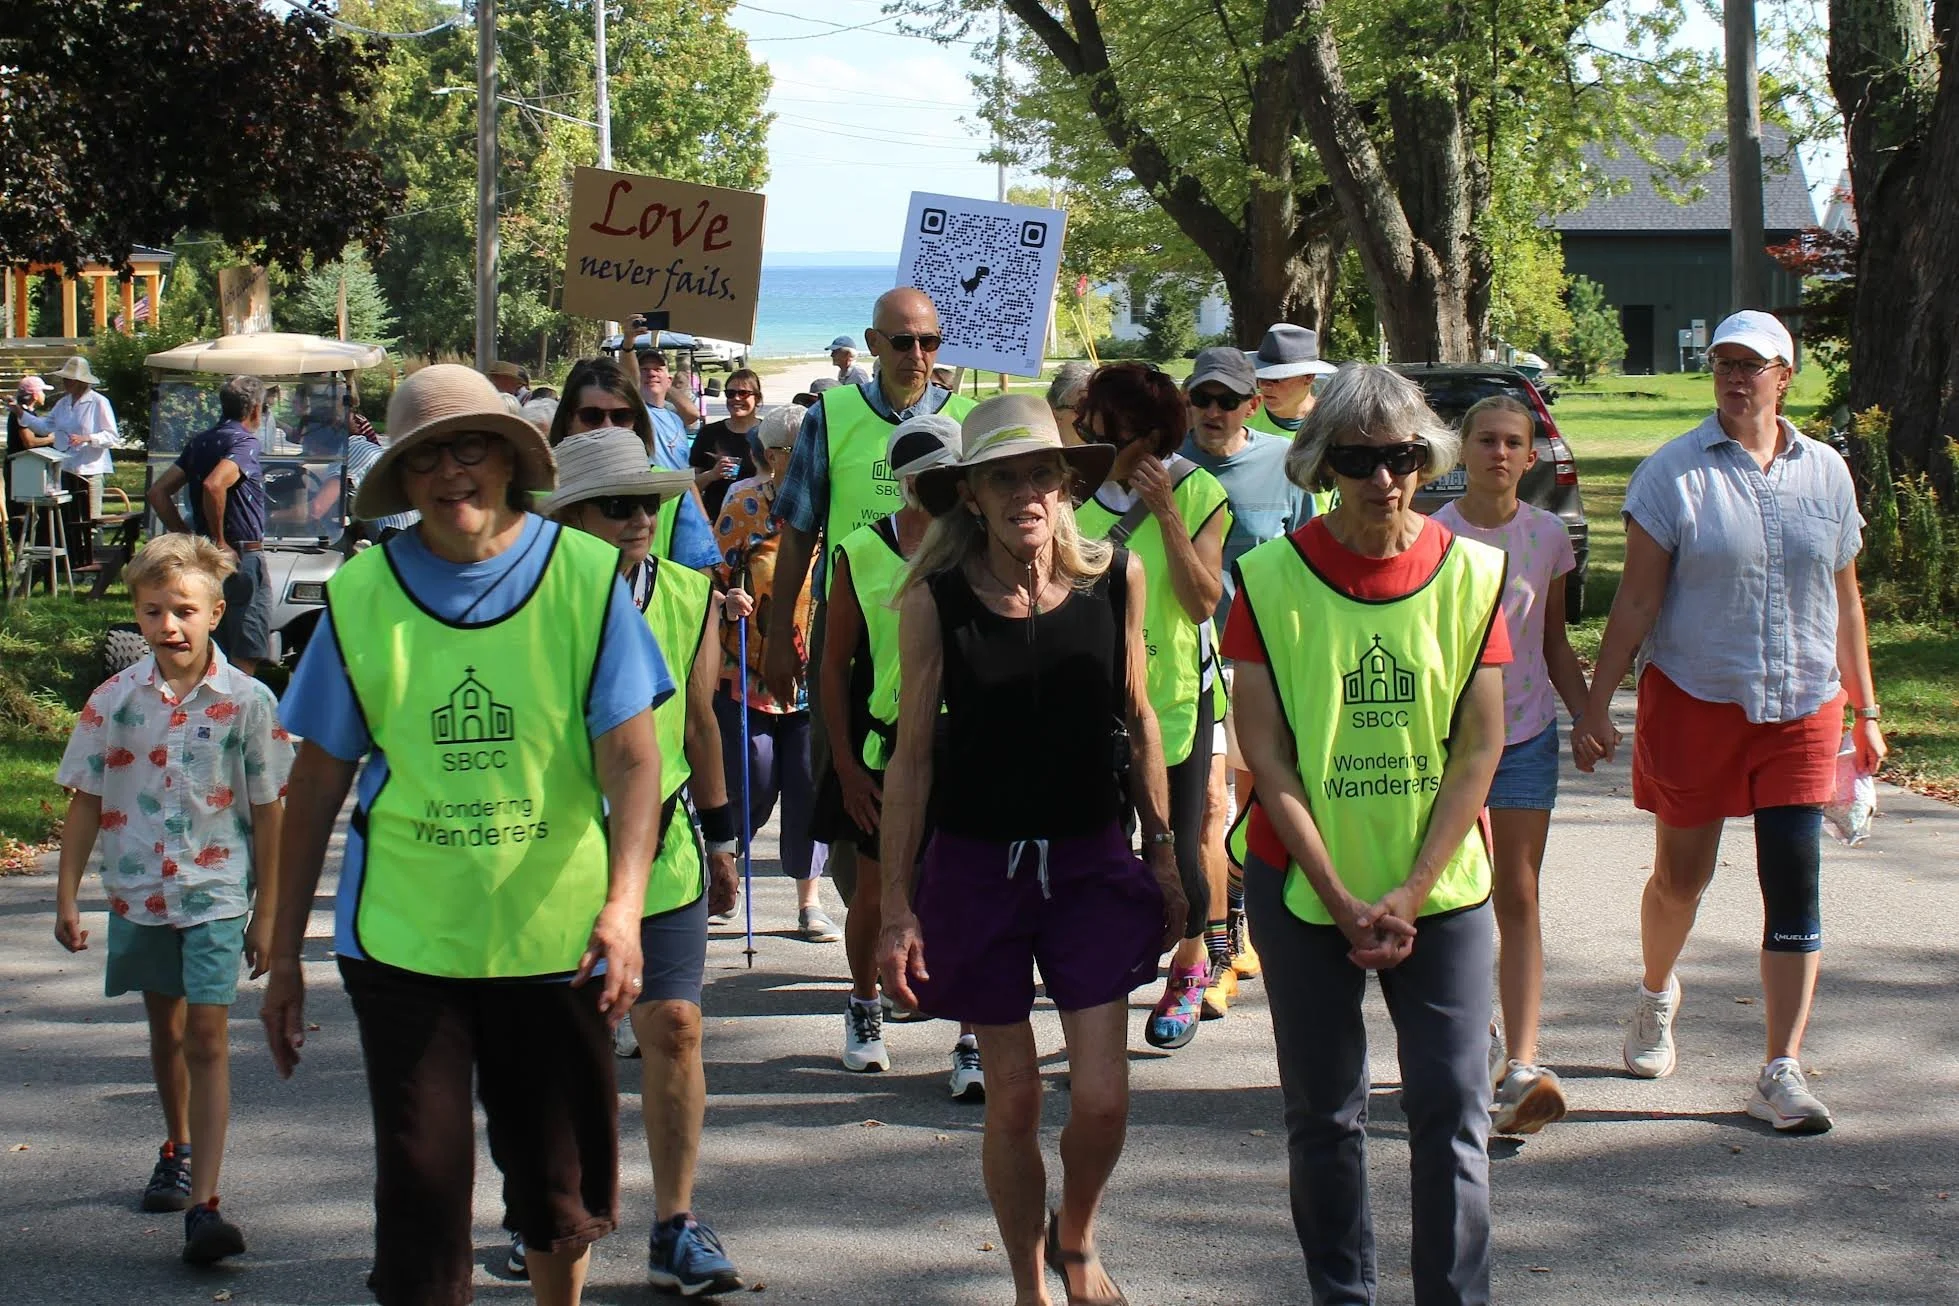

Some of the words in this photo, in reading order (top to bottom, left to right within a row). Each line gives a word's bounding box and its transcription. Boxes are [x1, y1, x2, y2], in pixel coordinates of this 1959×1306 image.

[589, 179, 732, 251] Love
[579, 256, 660, 286] never
[654, 258, 736, 309] fails.
[1352, 710, 1409, 728] SBCC
[442, 749, 508, 771] SBCC
[1333, 752, 1428, 772] Wondering
[1323, 773, 1439, 800] Wanderers
[425, 798, 533, 818] Wondering
[410, 820, 549, 847] Wanderers
